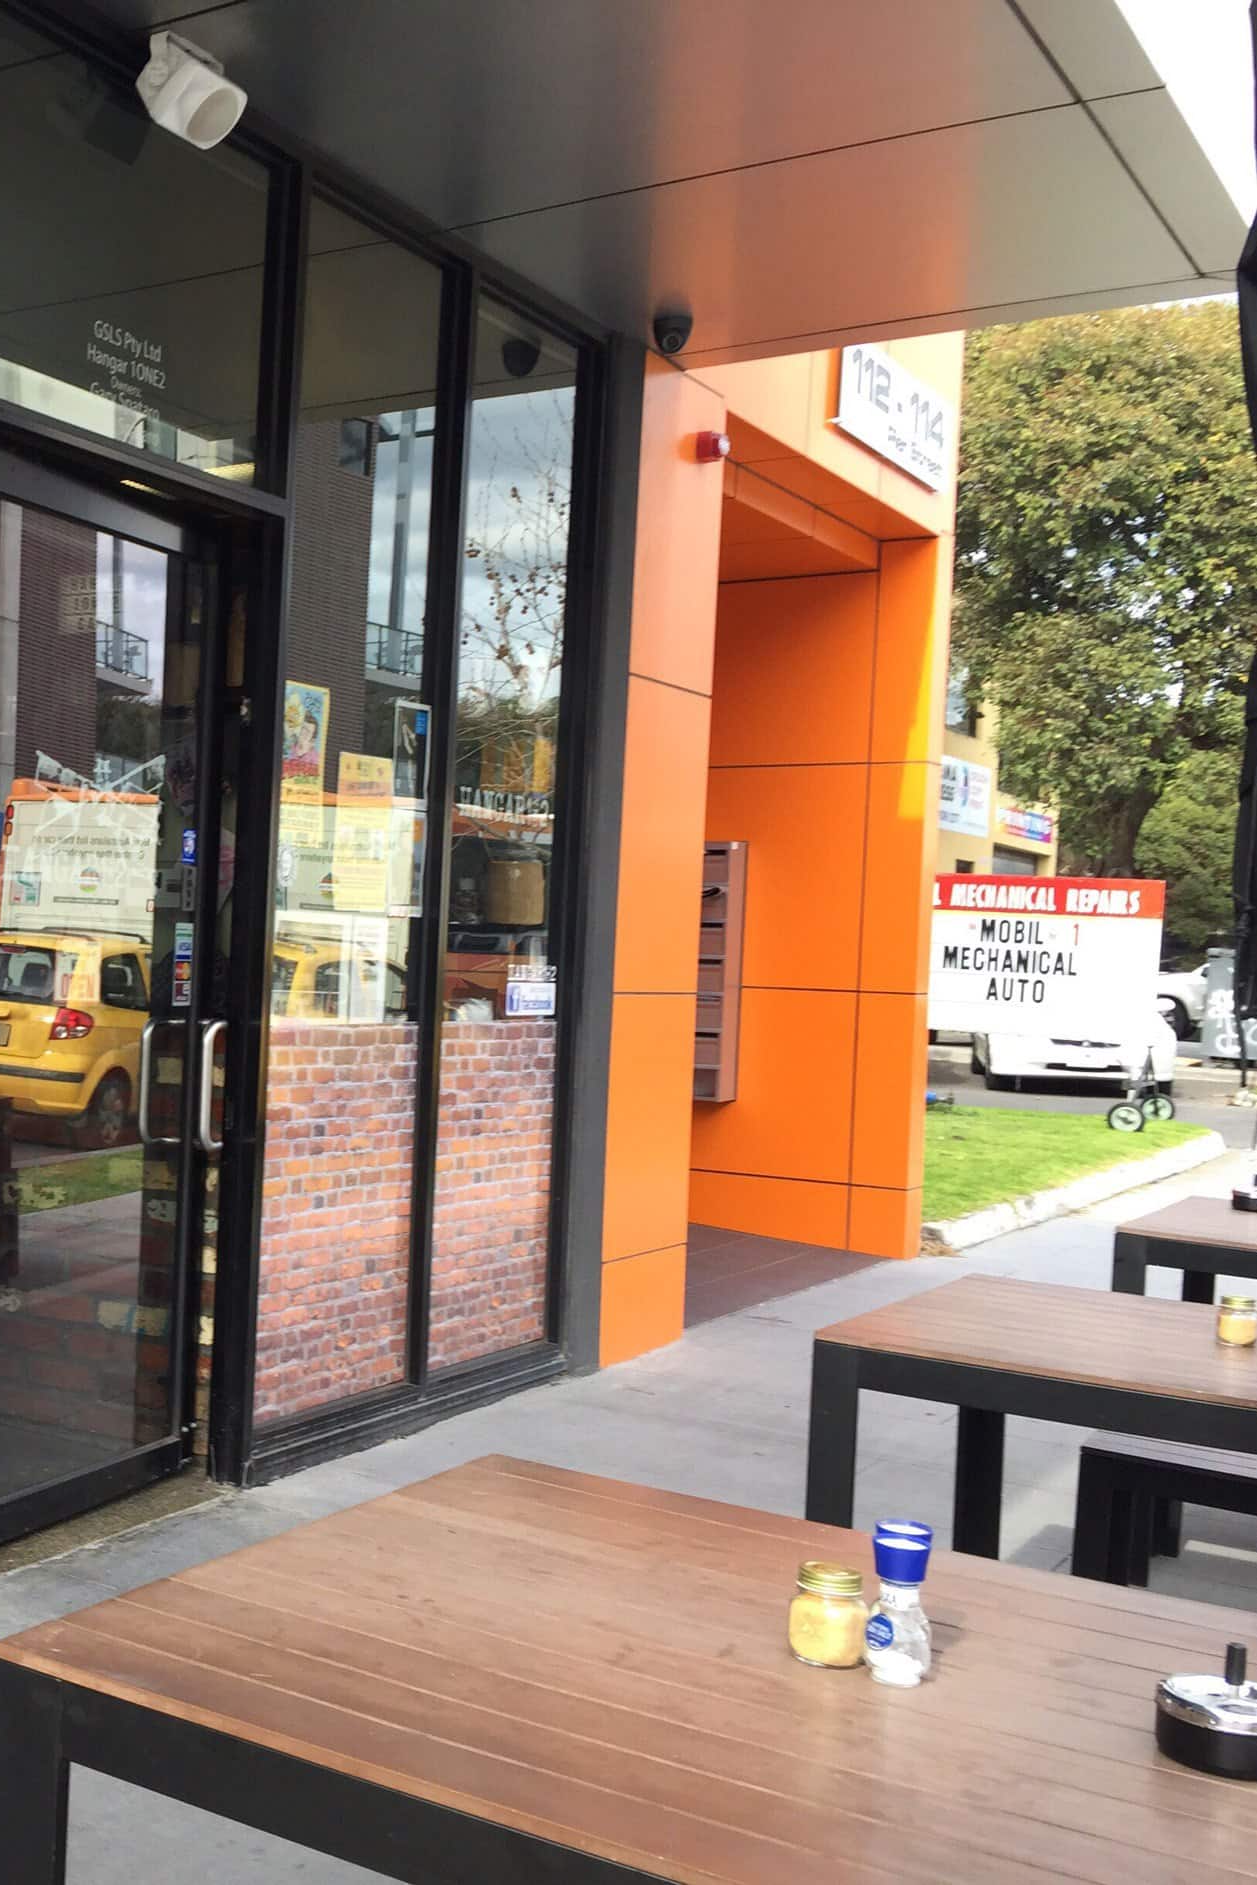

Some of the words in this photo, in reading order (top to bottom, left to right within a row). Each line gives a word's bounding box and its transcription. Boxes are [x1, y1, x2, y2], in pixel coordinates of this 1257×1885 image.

[87, 343, 128, 374] Hangar
[124, 332, 142, 358] Pty
[144, 340, 162, 363] Ltd
[853, 348, 891, 414] 112
[910, 392, 944, 449] 114
[950, 883, 1057, 912] MECHANICAL
[1065, 888, 1141, 916] REPAIRS
[980, 918, 1044, 945] MOBIL
[1073, 923, 1079, 946] 1
[942, 945, 1077, 976] MECHANICAL
[986, 977, 1045, 1003] AUTO
